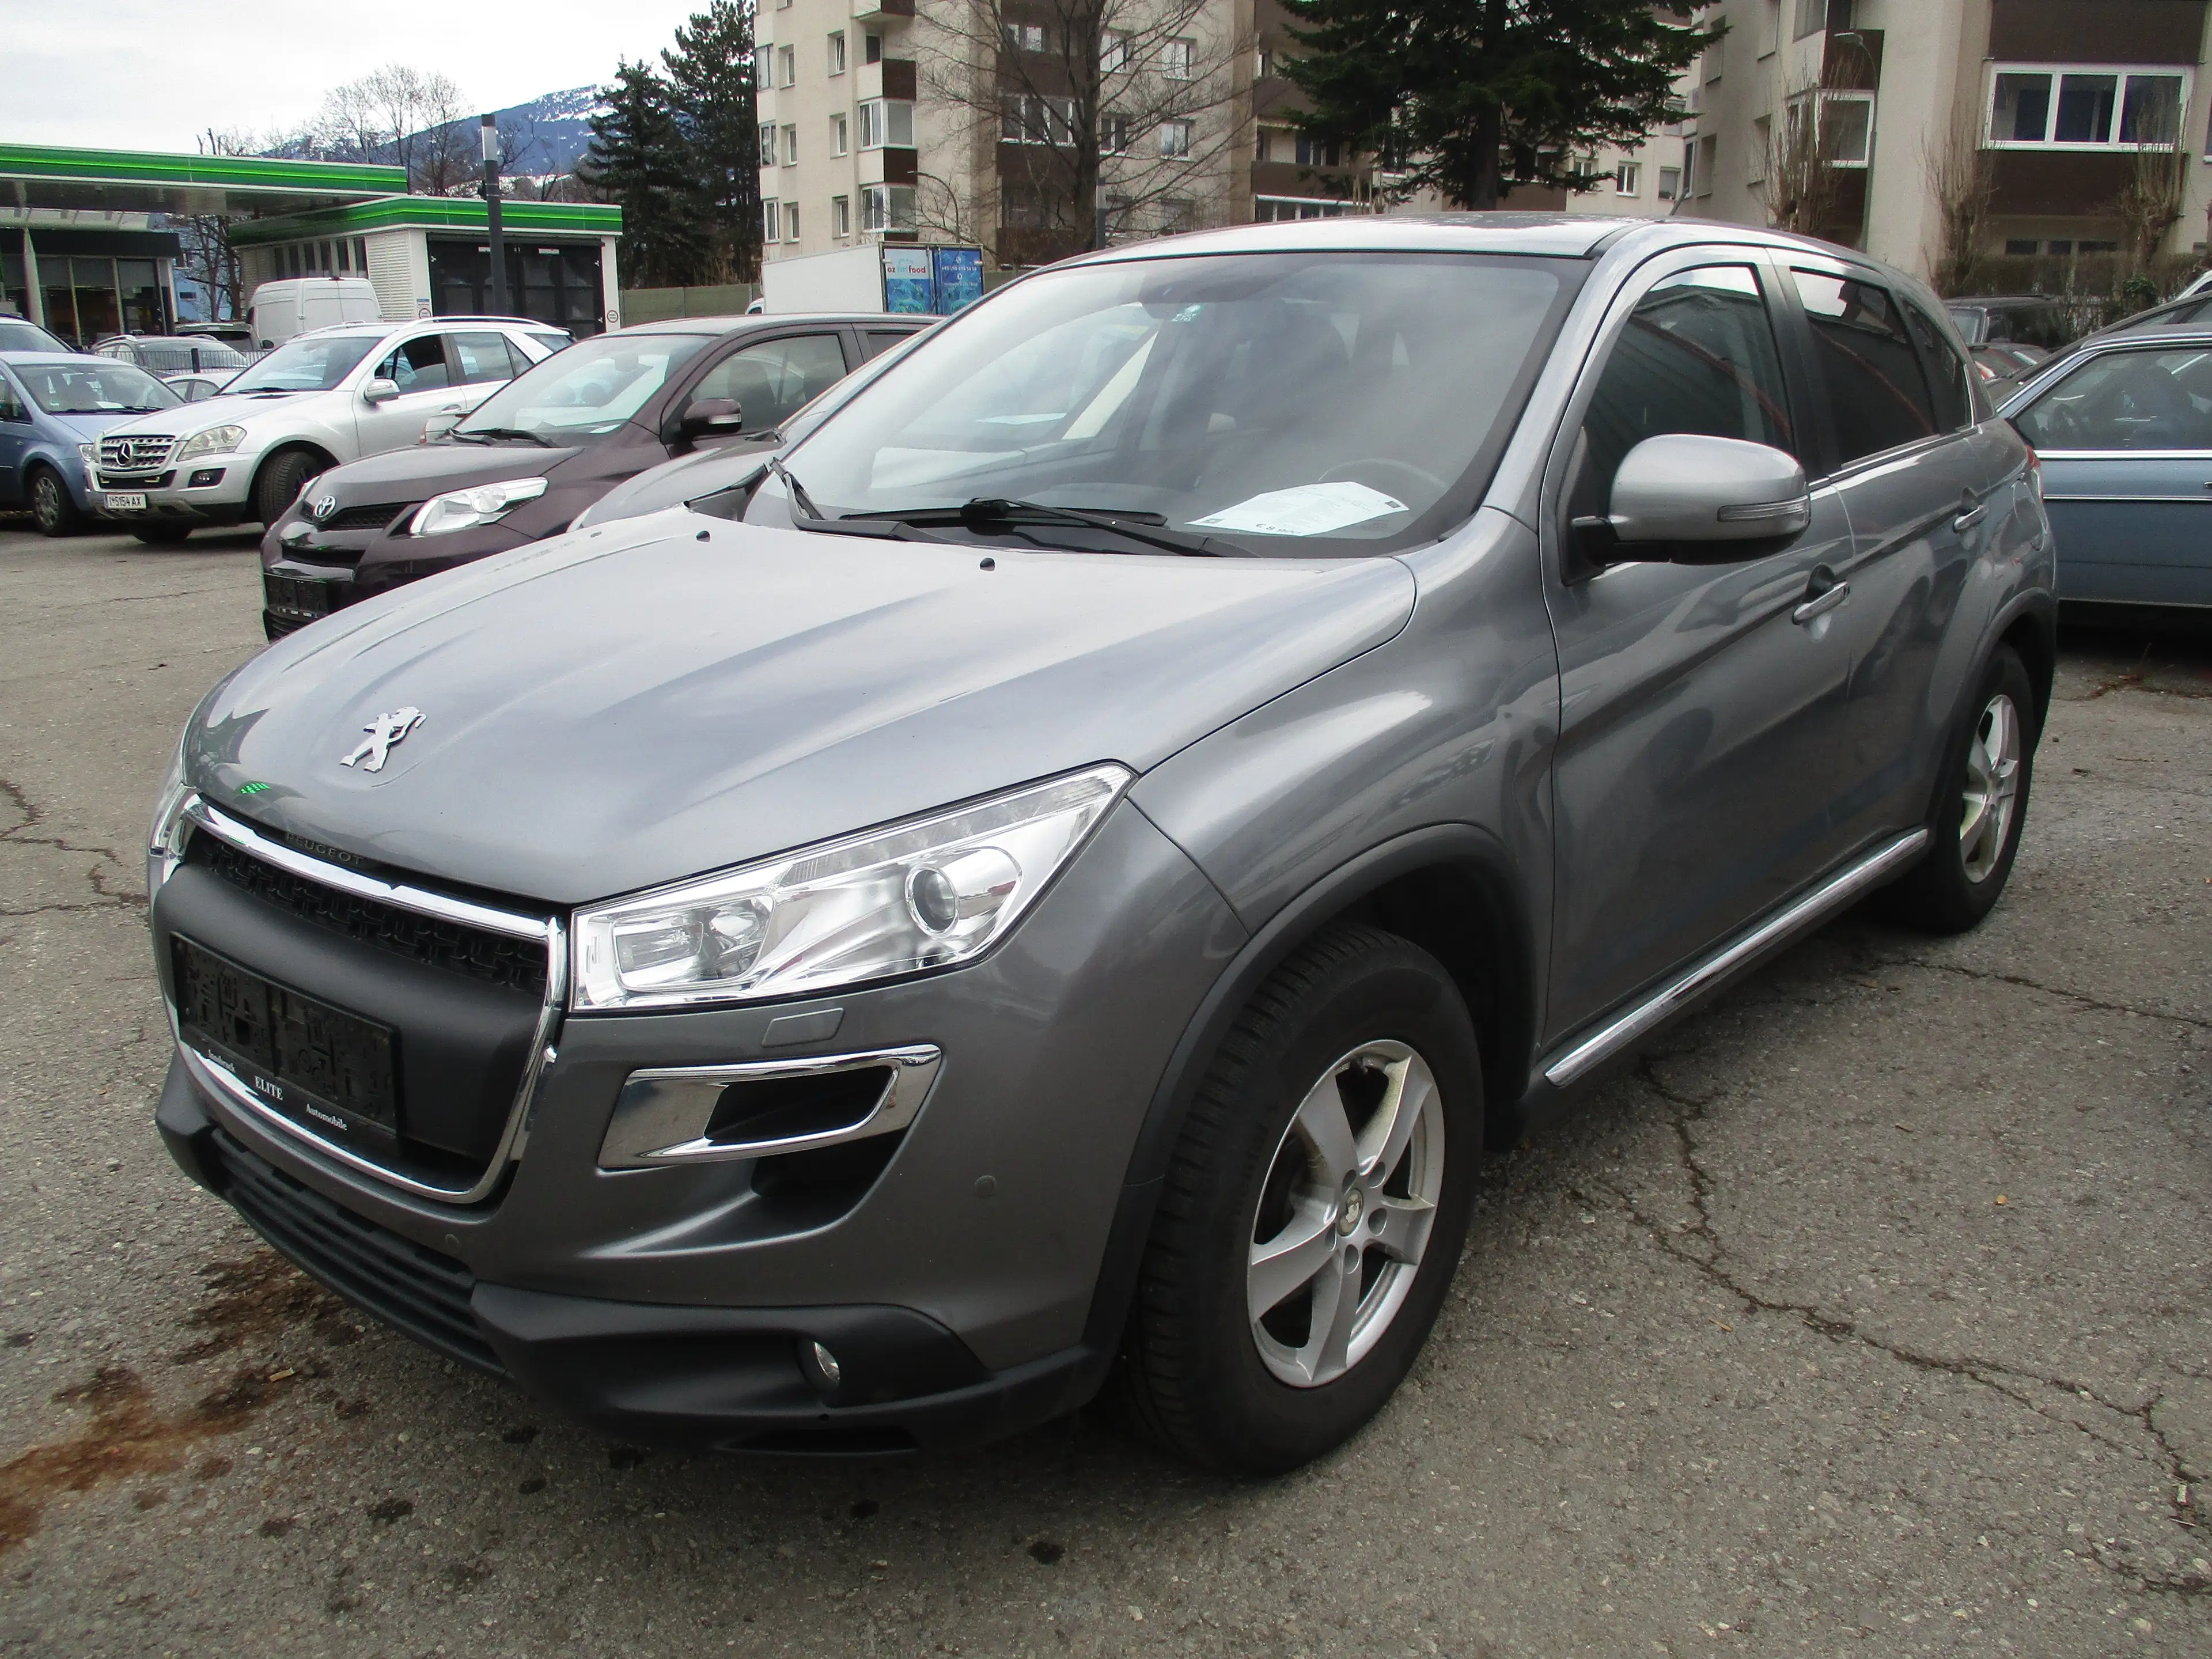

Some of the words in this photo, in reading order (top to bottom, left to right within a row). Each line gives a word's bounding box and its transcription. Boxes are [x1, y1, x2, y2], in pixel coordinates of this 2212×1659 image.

[908, 265, 926, 273] food
[287, 833, 364, 865] PEUGEOT
[255, 1075, 284, 1101] ELITE
[306, 1104, 348, 1131] Automobile
